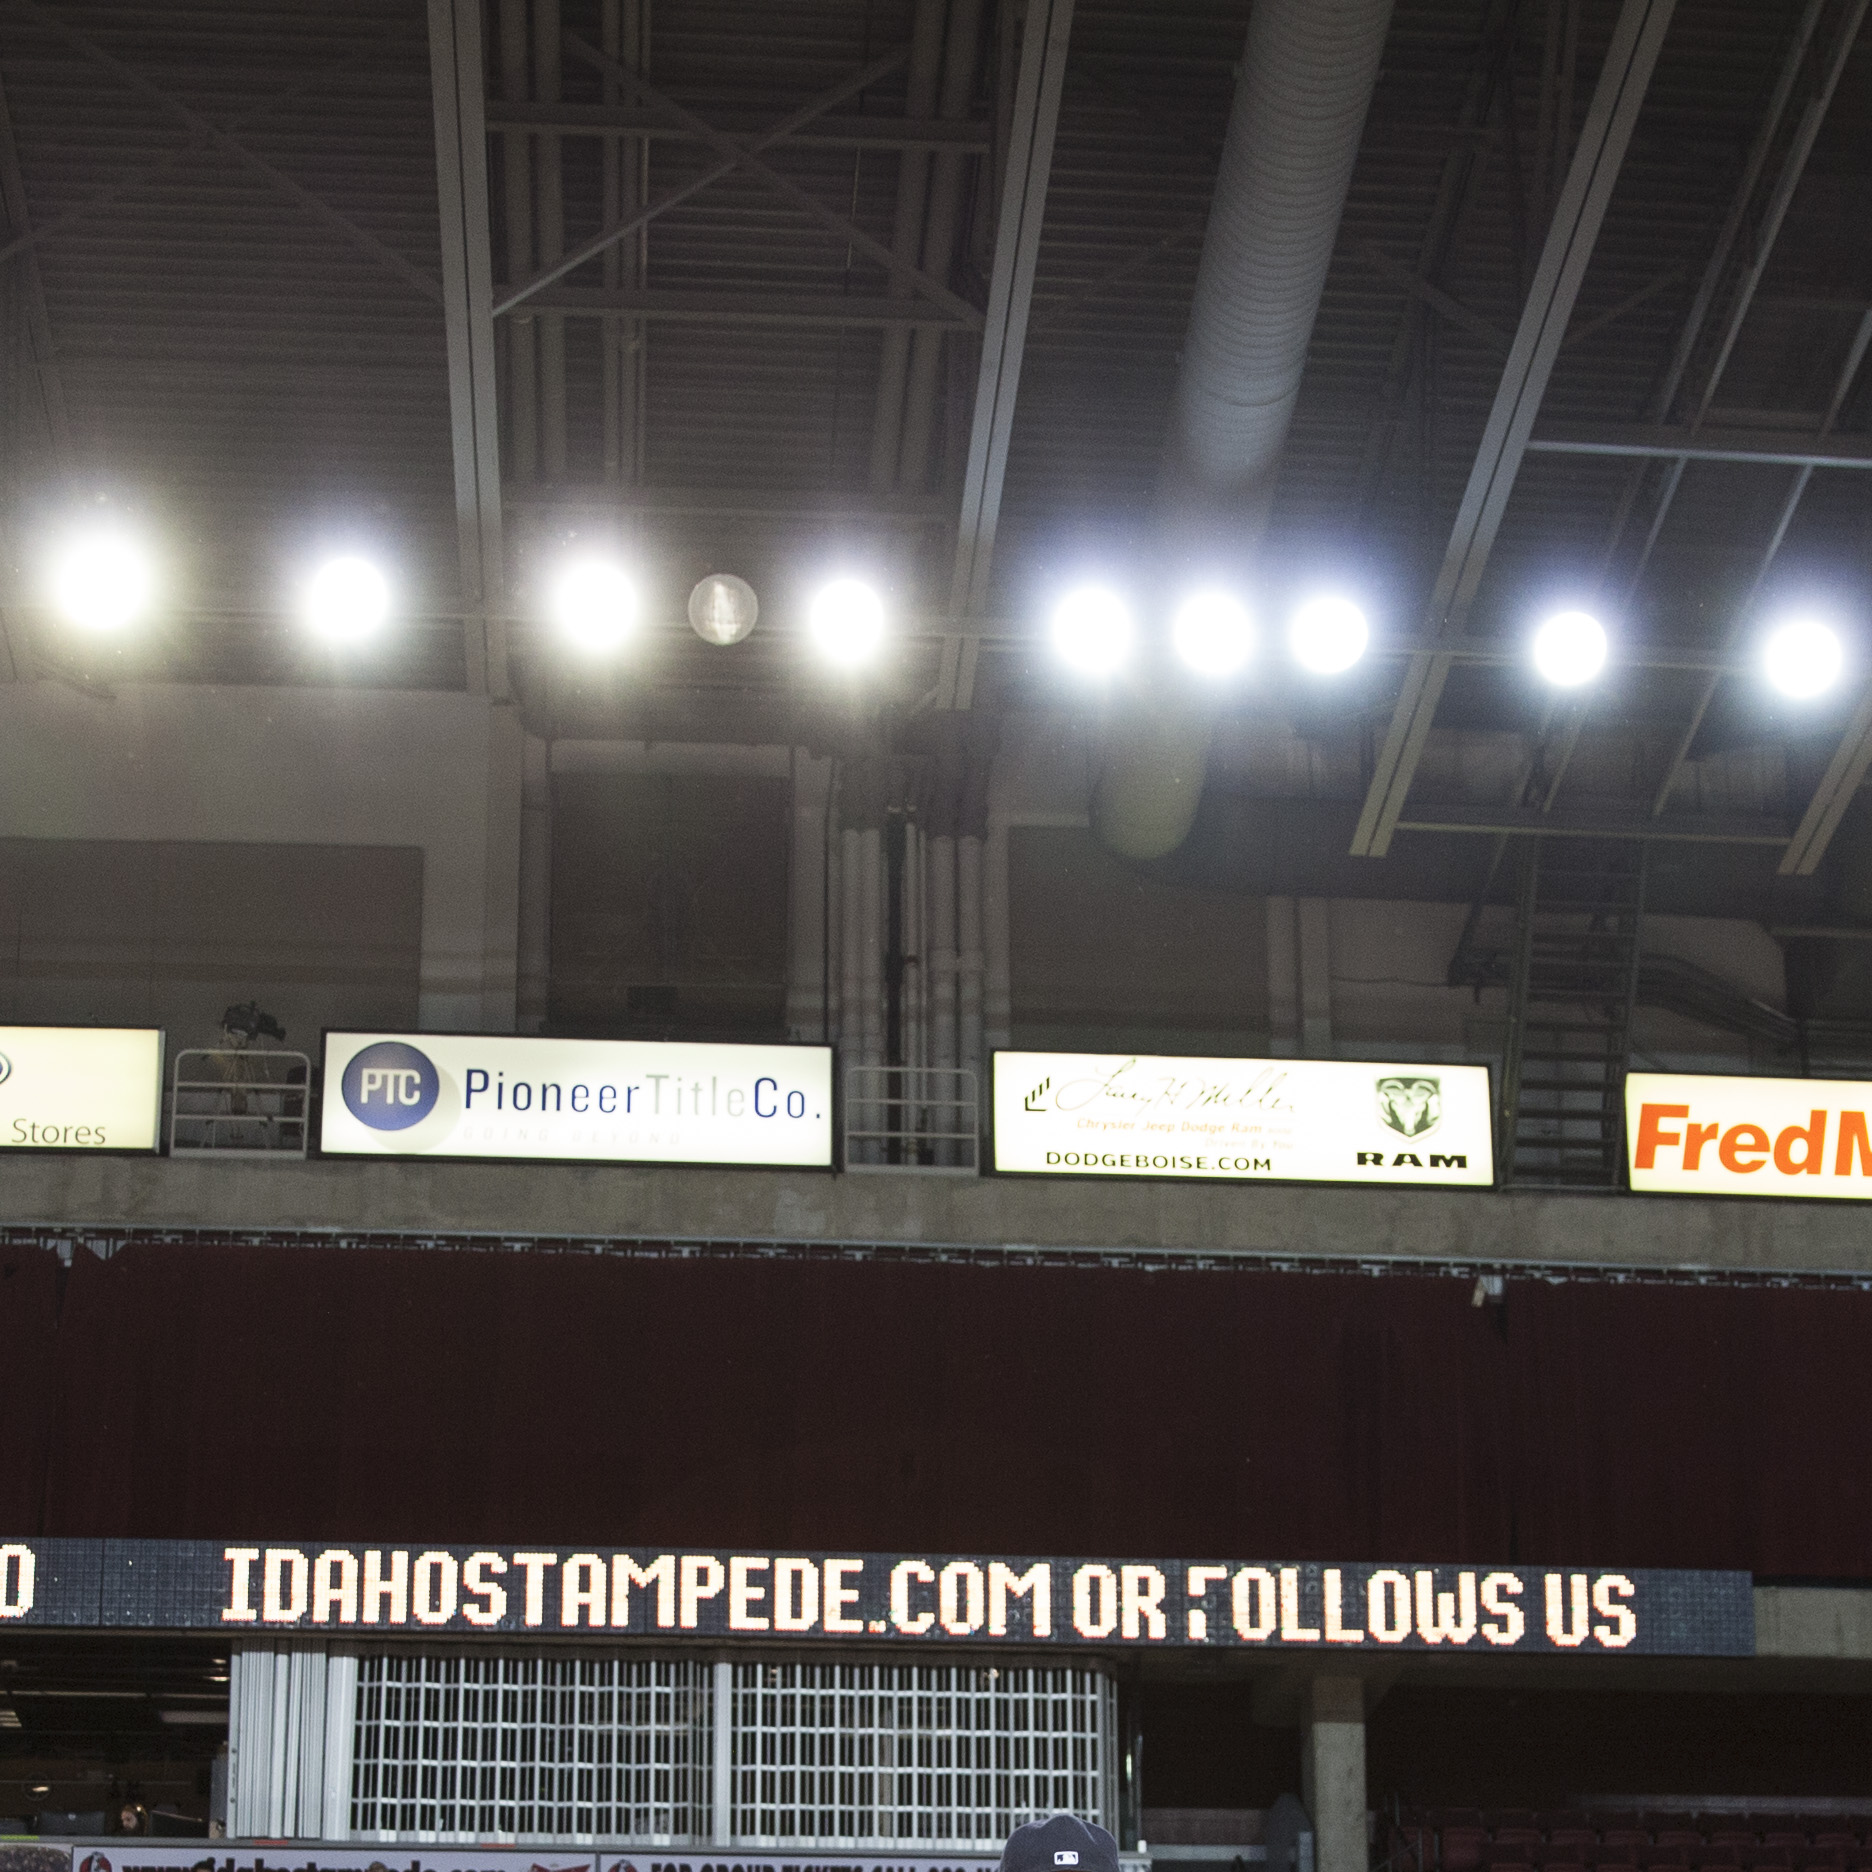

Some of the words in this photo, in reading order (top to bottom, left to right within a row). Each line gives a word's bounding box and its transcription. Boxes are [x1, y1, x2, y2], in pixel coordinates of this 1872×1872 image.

[359, 1066, 422, 1107] PTC
[11, 1117, 108, 1146] Stores
[1180, 1119, 1226, 1134] Dodge
[1045, 1150, 1273, 1172] DODGEBOISE.COM
[1356, 1151, 1469, 1169] RAM
[221, 1547, 1053, 1640] IDAHOSTAMPEDE.COM
[1072, 1564, 1167, 1642] OR
[1544, 1573, 1638, 1648] US
